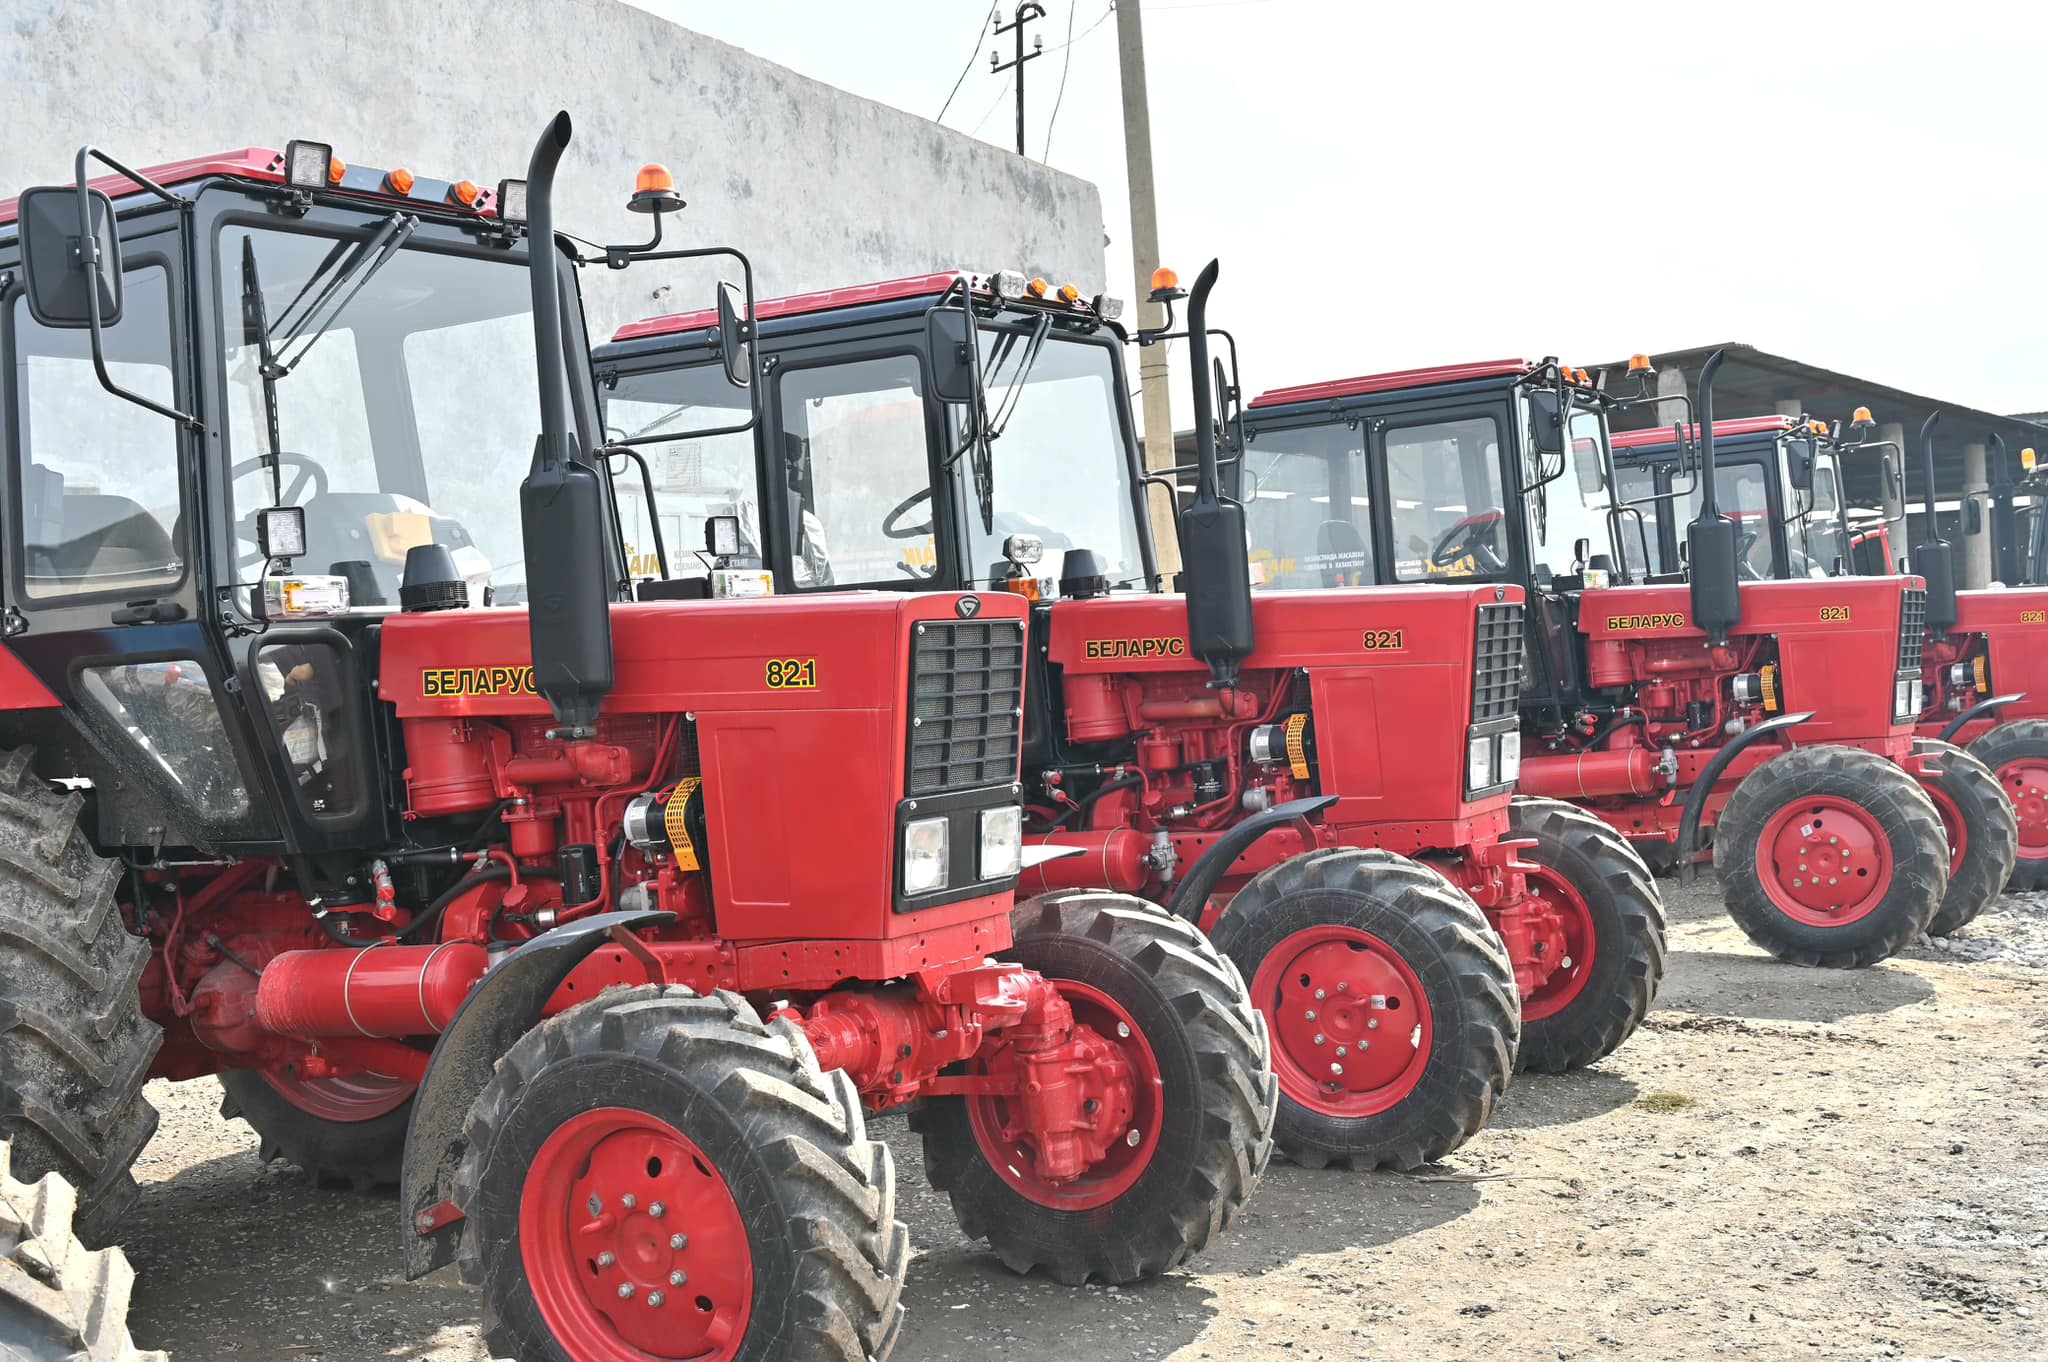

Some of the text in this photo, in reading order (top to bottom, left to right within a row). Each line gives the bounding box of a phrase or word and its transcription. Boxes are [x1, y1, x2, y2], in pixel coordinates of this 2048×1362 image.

[630, 553, 661, 576] AIK
[1608, 613, 1685, 631] БЕЛАРУС
[1819, 606, 1850, 621] 82.1
[2021, 610, 2046, 624] 82.1
[1086, 637, 1184, 659] БЕЛАРУС
[1363, 630, 1403, 650] 82.1
[423, 666, 538, 696] БЕЛАРУС
[766, 659, 817, 689] 82.1
